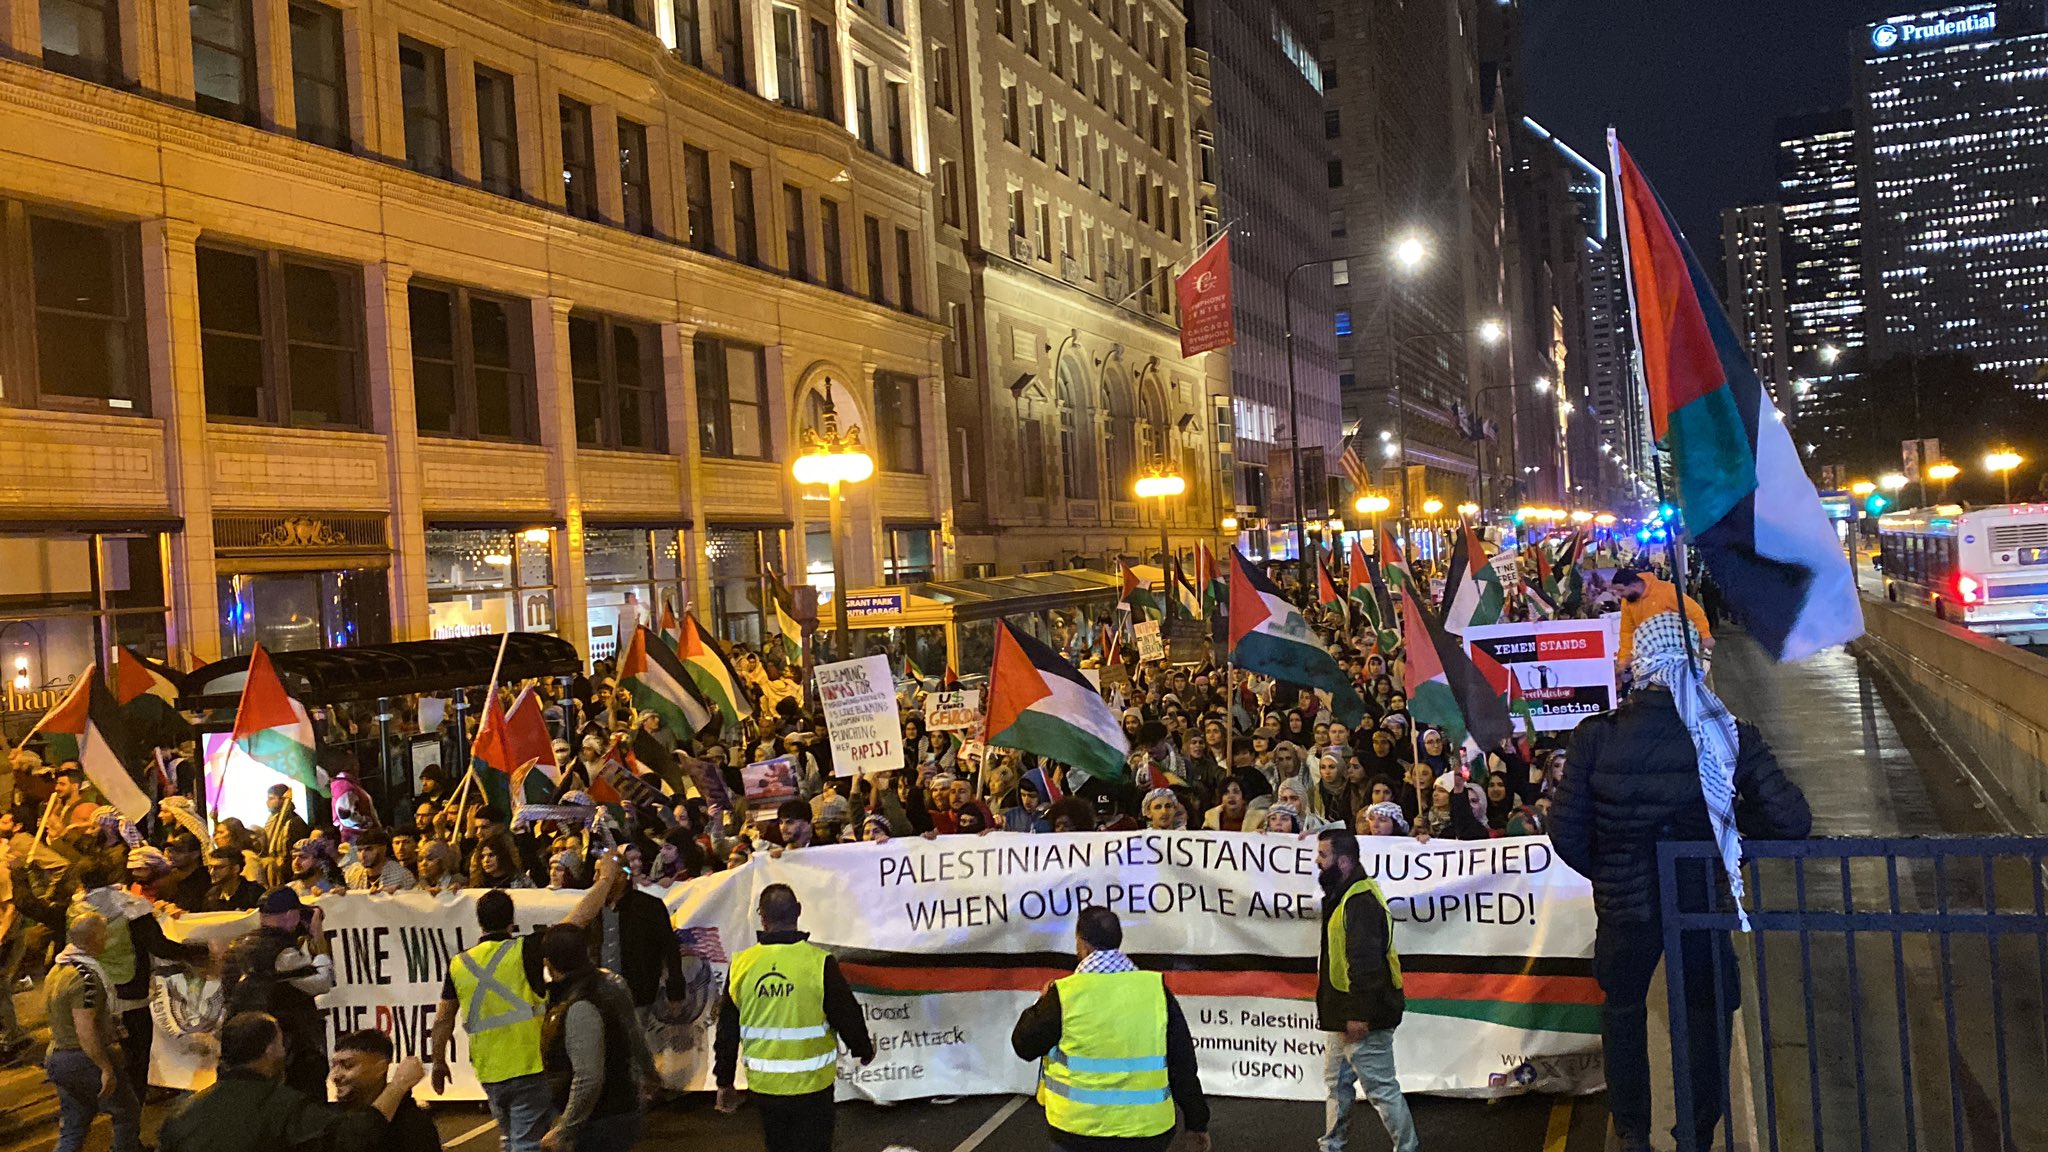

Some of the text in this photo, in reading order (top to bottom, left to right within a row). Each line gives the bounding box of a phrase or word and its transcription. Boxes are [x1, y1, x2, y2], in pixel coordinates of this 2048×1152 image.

[1902, 11, 1997, 41] Prudential
[1188, 321, 1229, 337] CHICAGO
[846, 597, 893, 608] GRANT PARK
[846, 606, 900, 617] OUTH GARAGE
[434, 621, 492, 641] mindworks
[1494, 639, 1587, 655] YEMEN STANDS
[819, 664, 867, 684] BLAMING
[855, 680, 873, 695] FOR
[1528, 703, 1600, 717] palestine
[831, 725, 876, 742] PUNCHING
[836, 742, 850, 751] HER
[879, 835, 1552, 887] PALESTINIAN RESISTANCE JUSTIFIED
[905, 882, 1536, 932] WHEN OUR PEOPLE ARE CUPIED!
[324, 926, 392, 987] TINE
[758, 983, 795, 998] AMP
[865, 1003, 911, 1020] lood
[1200, 1009, 1321, 1031] U.S. Palestinia
[1193, 1035, 1326, 1056] ommunity Netw
[1231, 1060, 1304, 1084] (USPCN)
